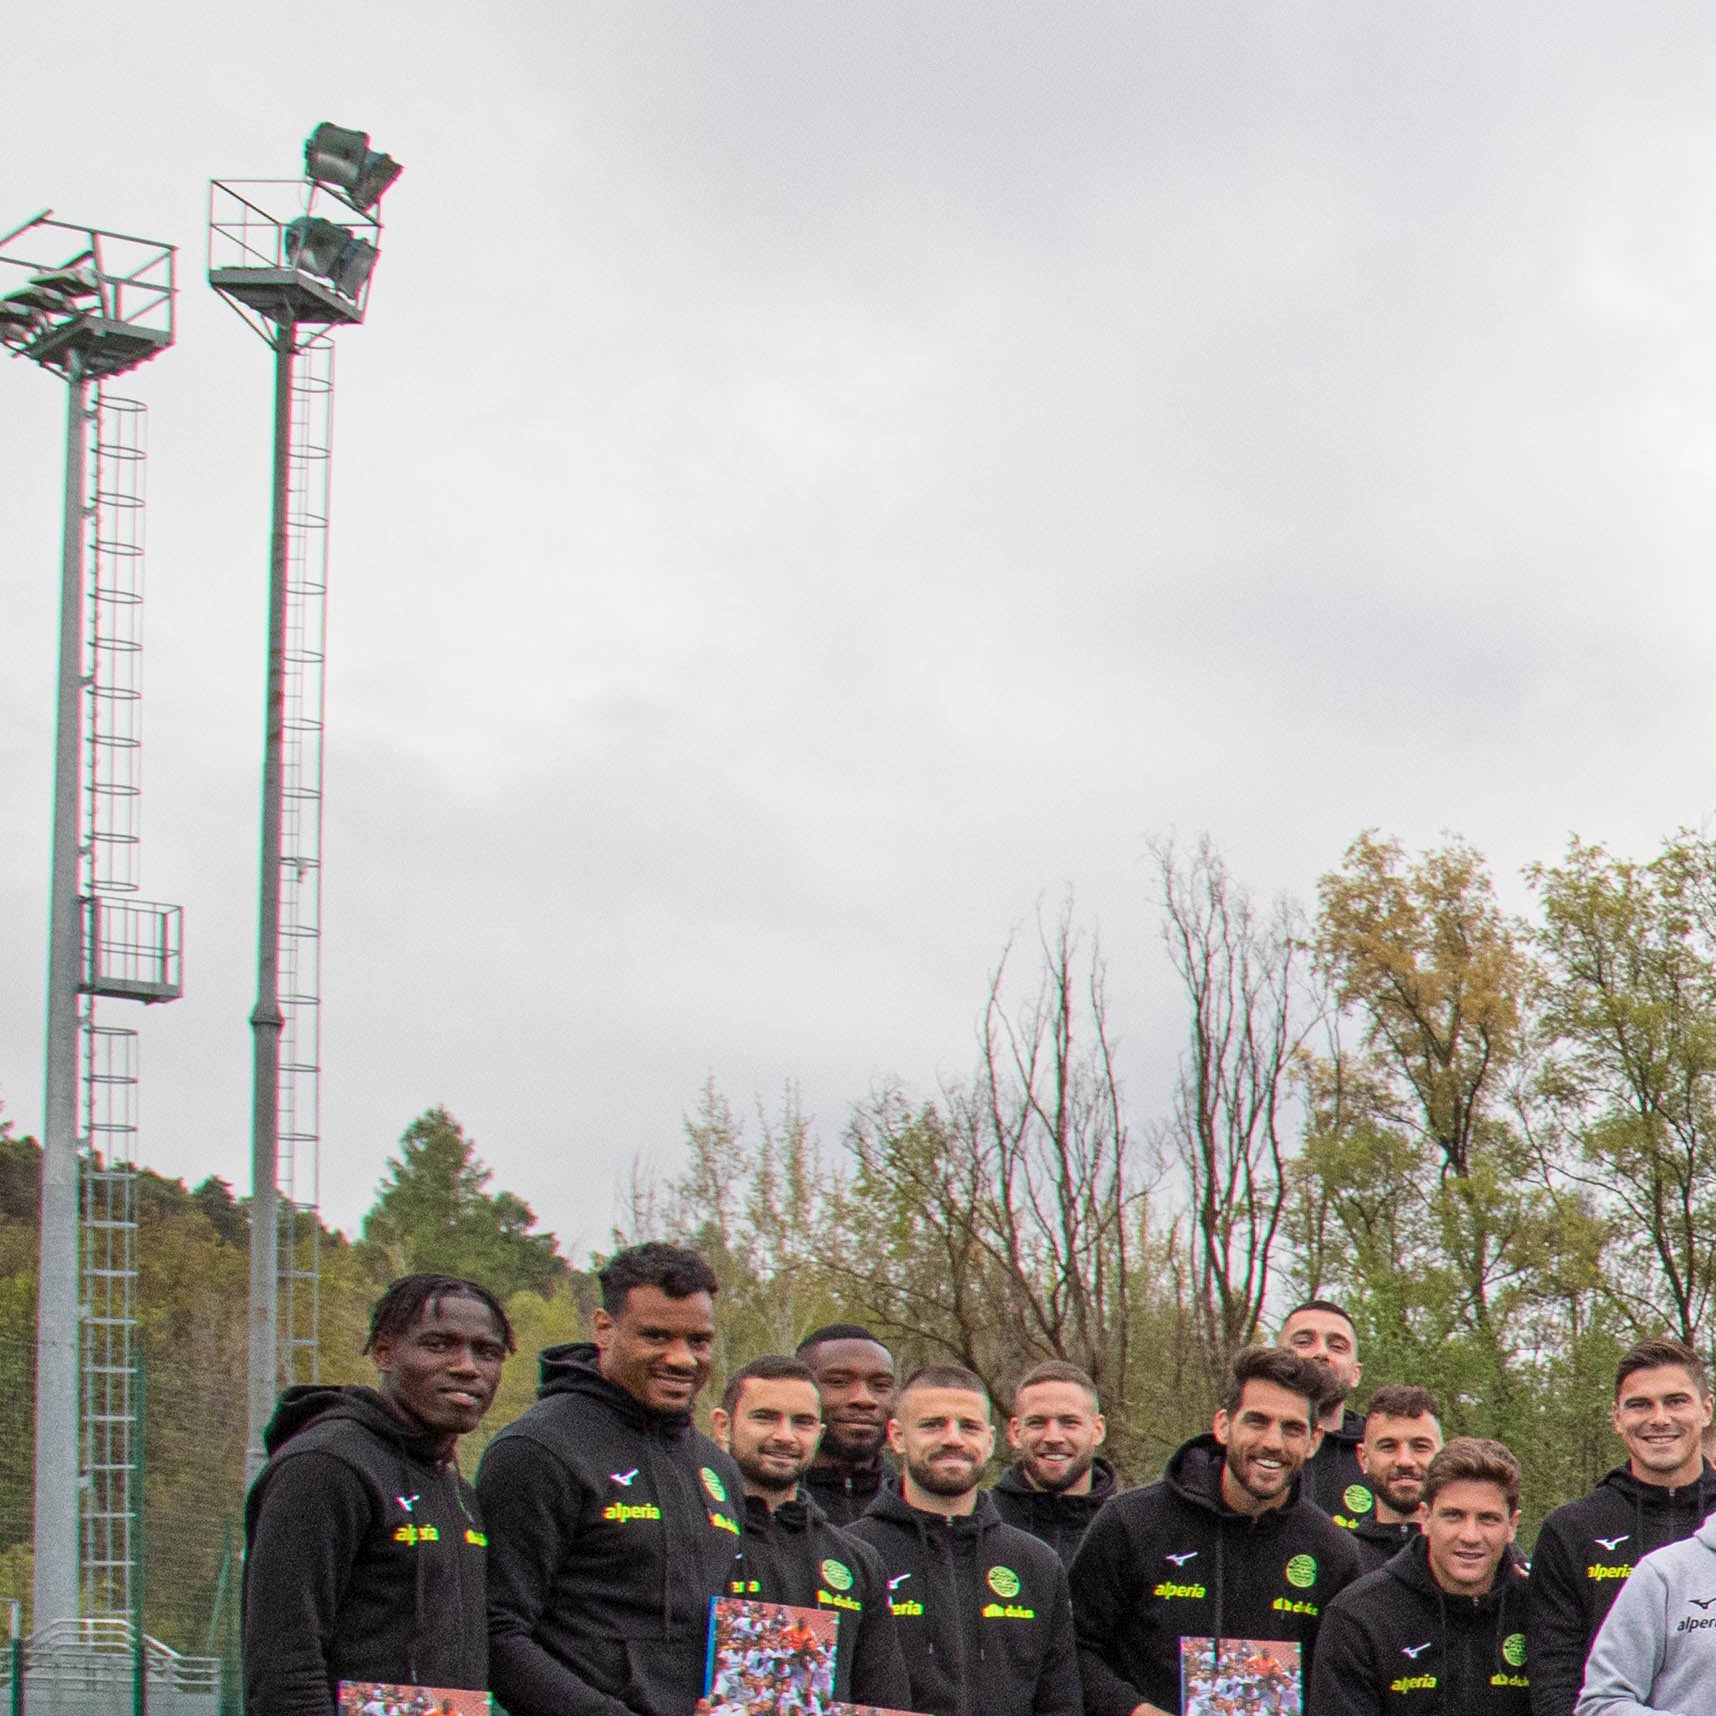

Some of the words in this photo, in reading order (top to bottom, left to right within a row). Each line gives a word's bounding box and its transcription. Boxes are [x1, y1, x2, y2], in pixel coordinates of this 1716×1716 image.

[604, 1502, 662, 1523] alperia
[1153, 1580, 1207, 1601] alperia
[892, 1600, 924, 1617] eria
[1389, 1673, 1438, 1695] alperia
